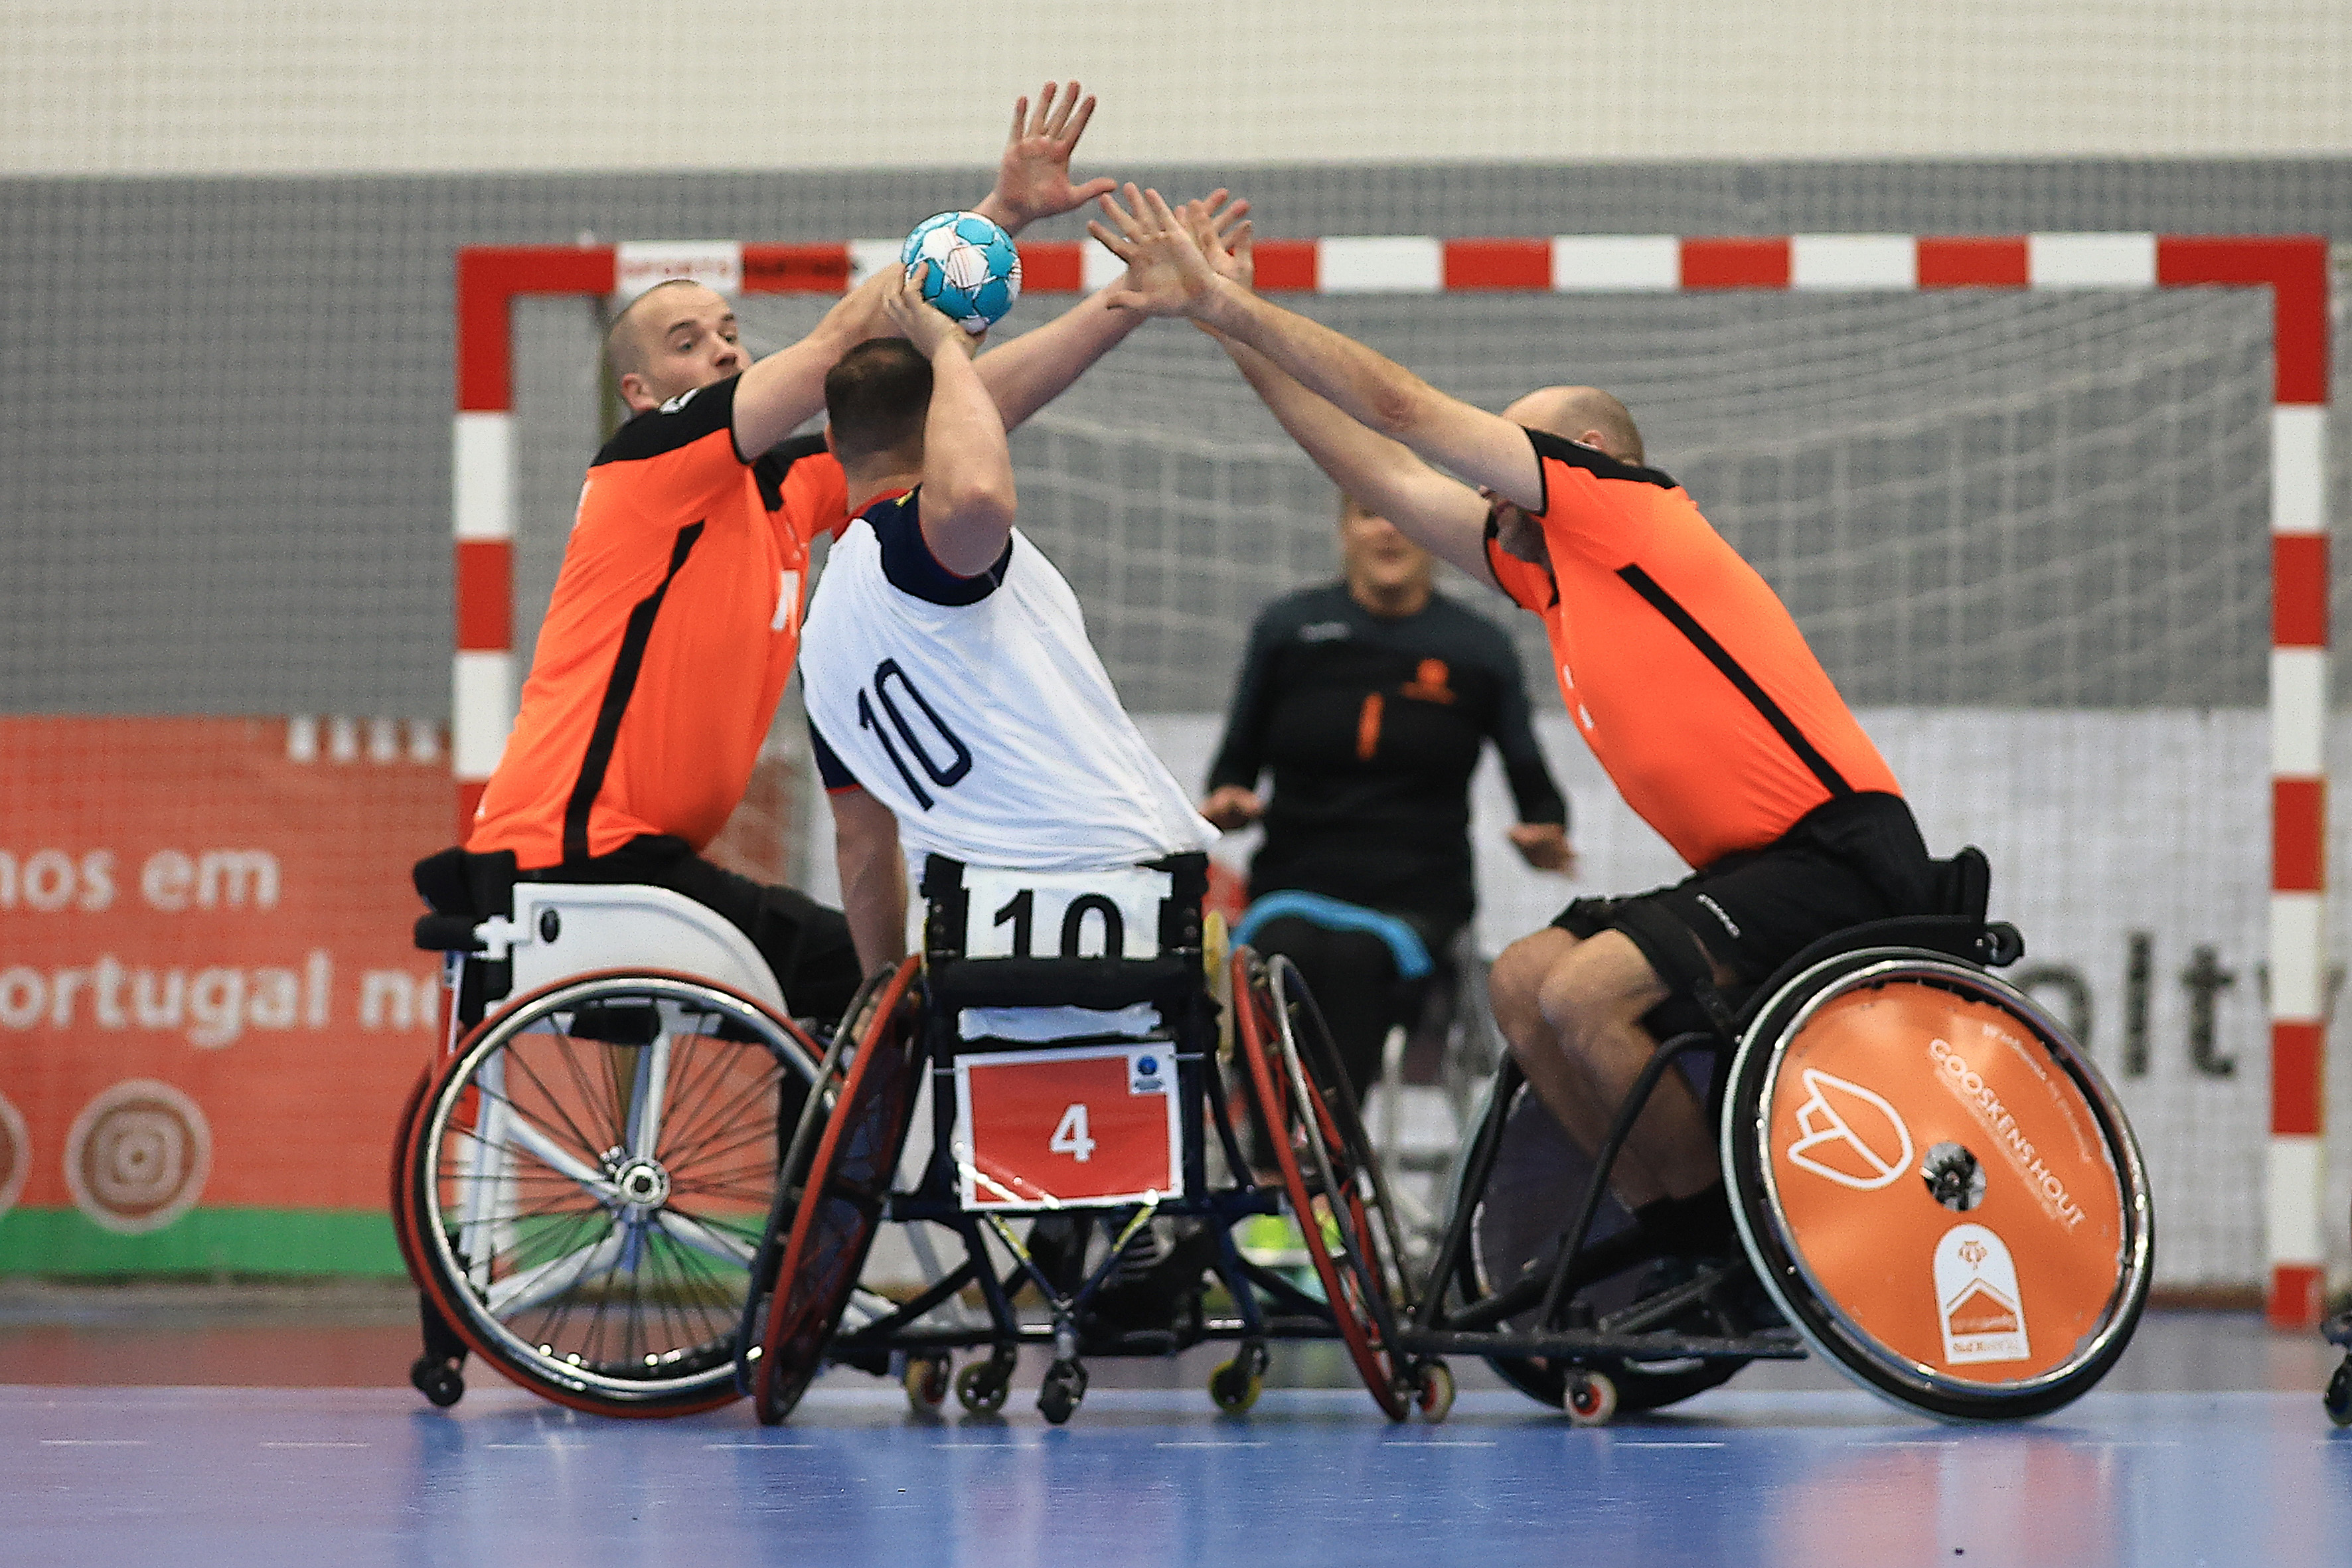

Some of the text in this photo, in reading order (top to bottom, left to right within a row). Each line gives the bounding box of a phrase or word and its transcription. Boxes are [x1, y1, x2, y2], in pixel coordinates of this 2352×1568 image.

[858, 657, 972, 811] 10
[140, 847, 281, 912] em
[994, 888, 1123, 959] 10
[0, 949, 332, 1050] ortugal
[1049, 1103, 1097, 1163] 4
[1929, 1038, 2035, 1163] GOOSKENS
[2028, 1156, 2086, 1227] HOUT
